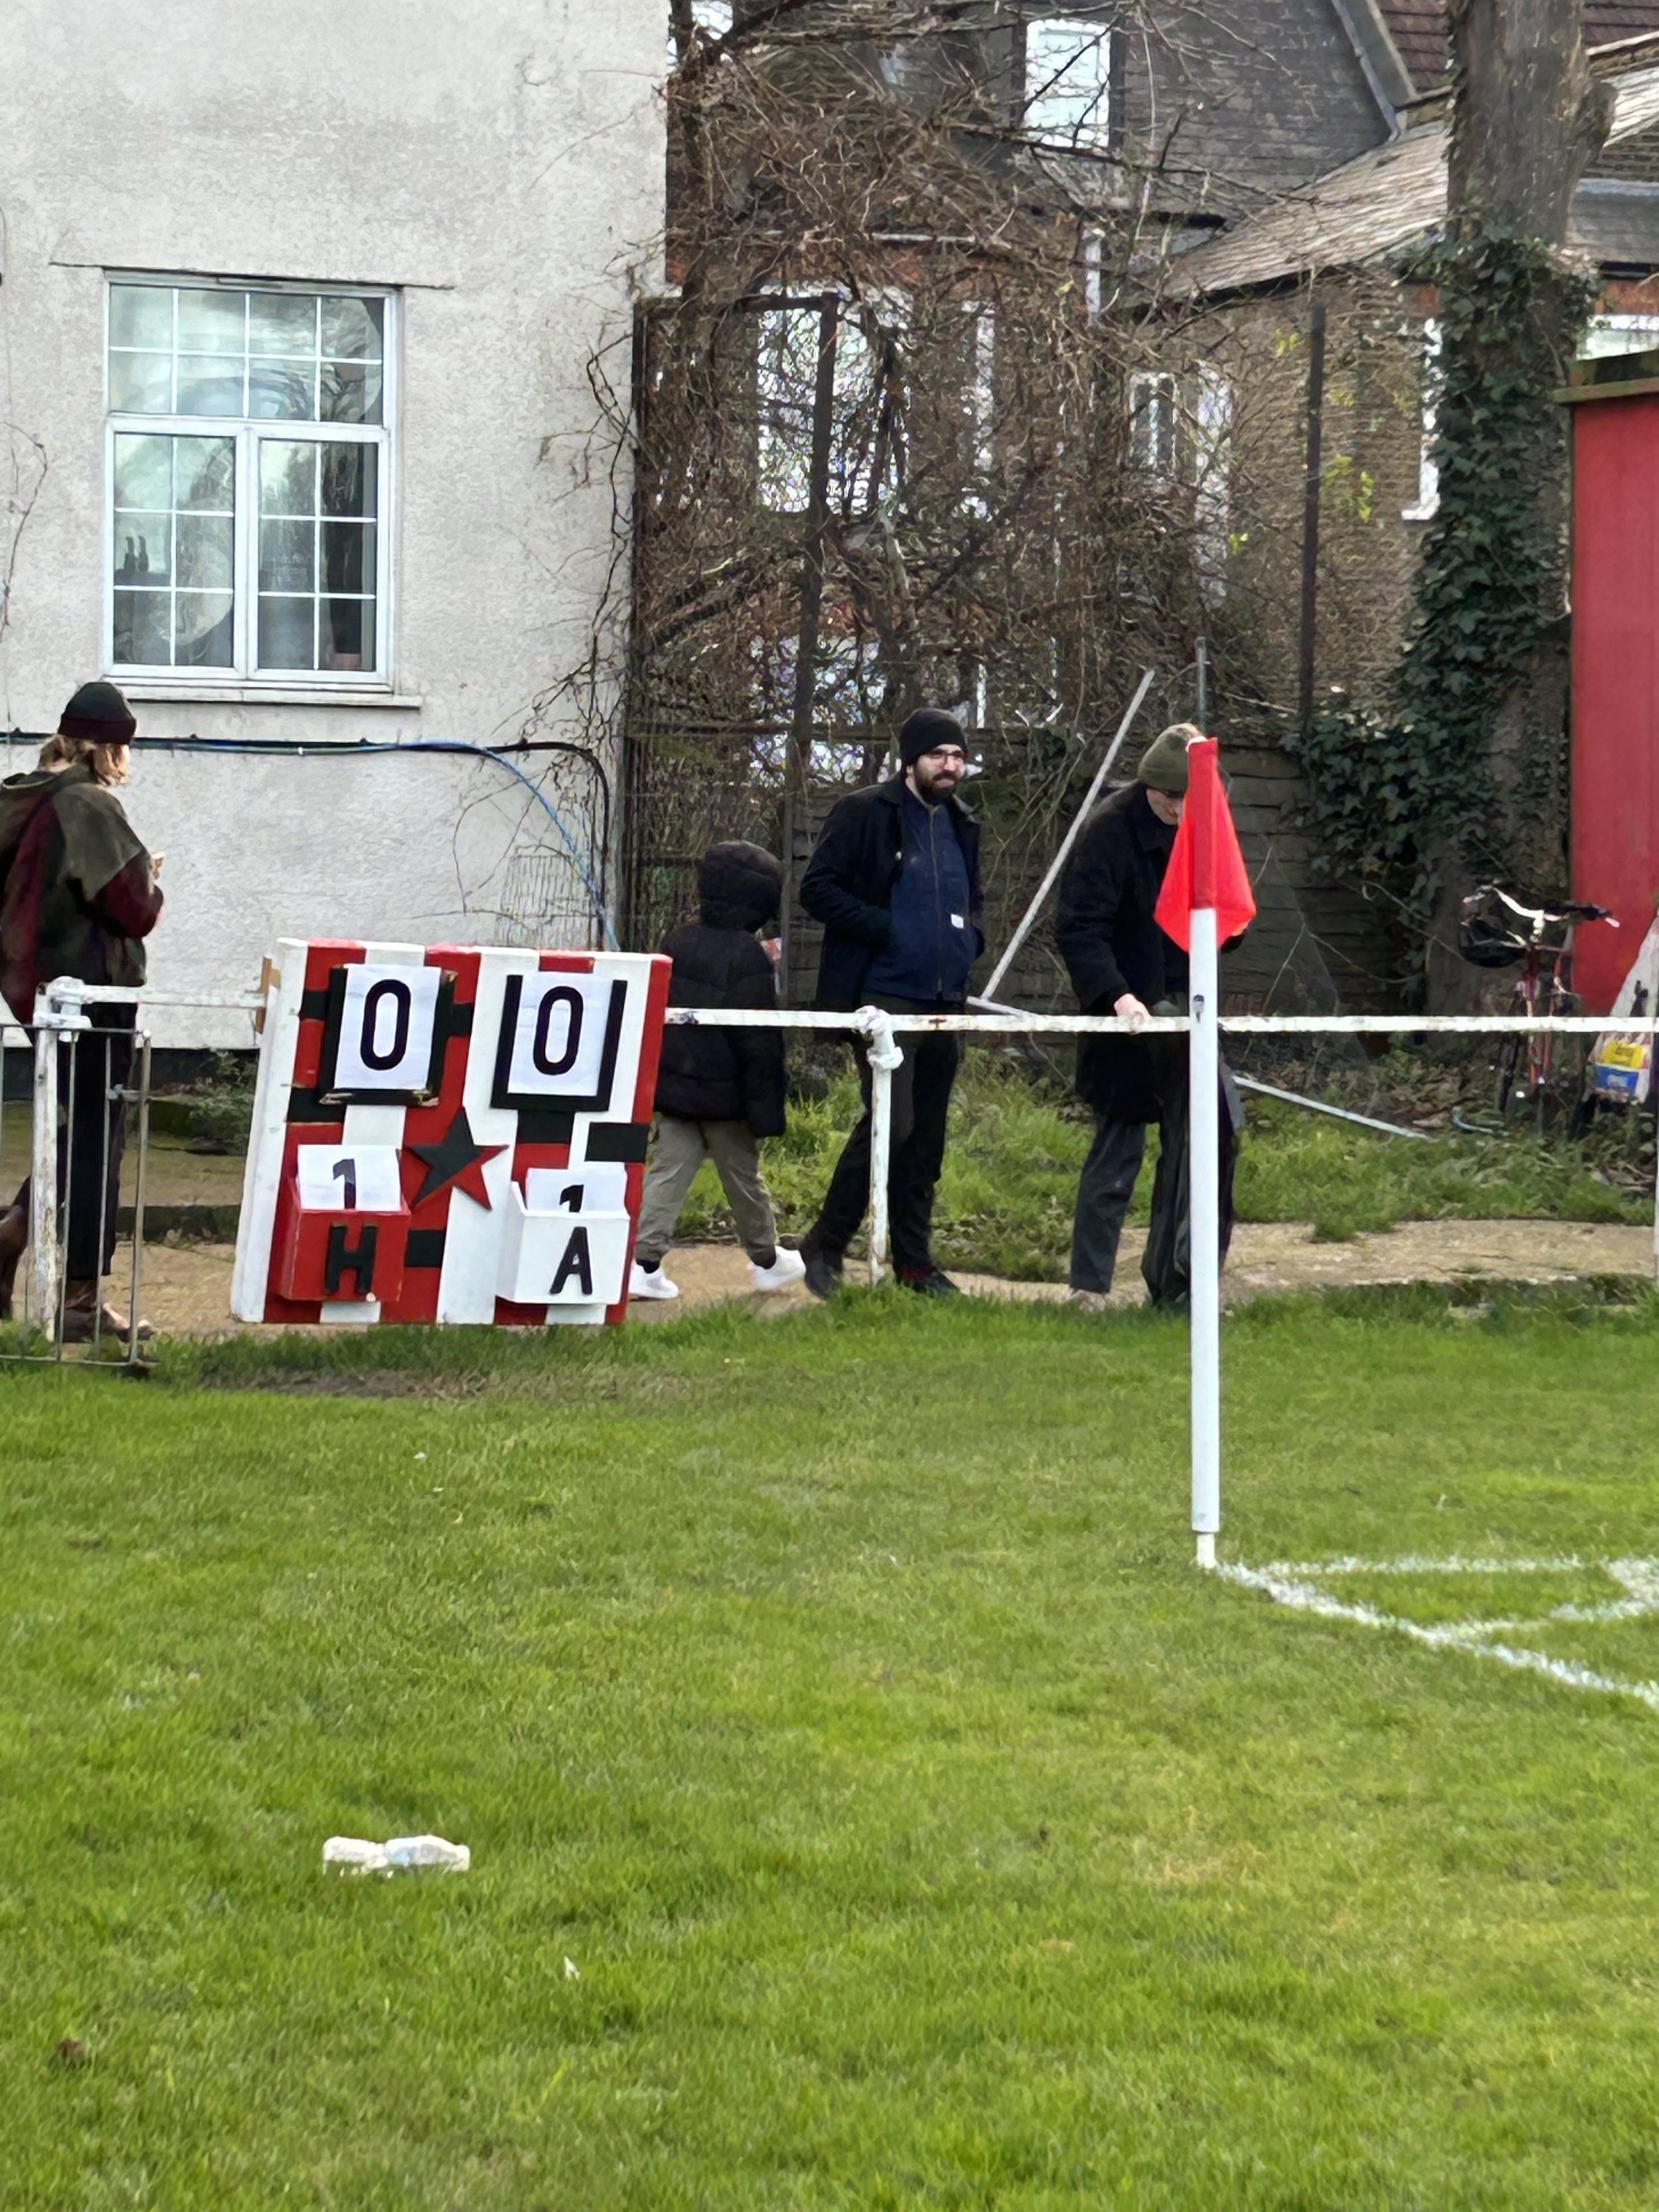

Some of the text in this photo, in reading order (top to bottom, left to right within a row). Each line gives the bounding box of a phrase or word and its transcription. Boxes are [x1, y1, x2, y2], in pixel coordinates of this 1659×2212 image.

[360, 979, 411, 1071] 0
[533, 986, 584, 1075] 0
[333, 1158, 356, 1209] 1
[325, 1223, 378, 1293] H
[549, 1226, 593, 1294] A
